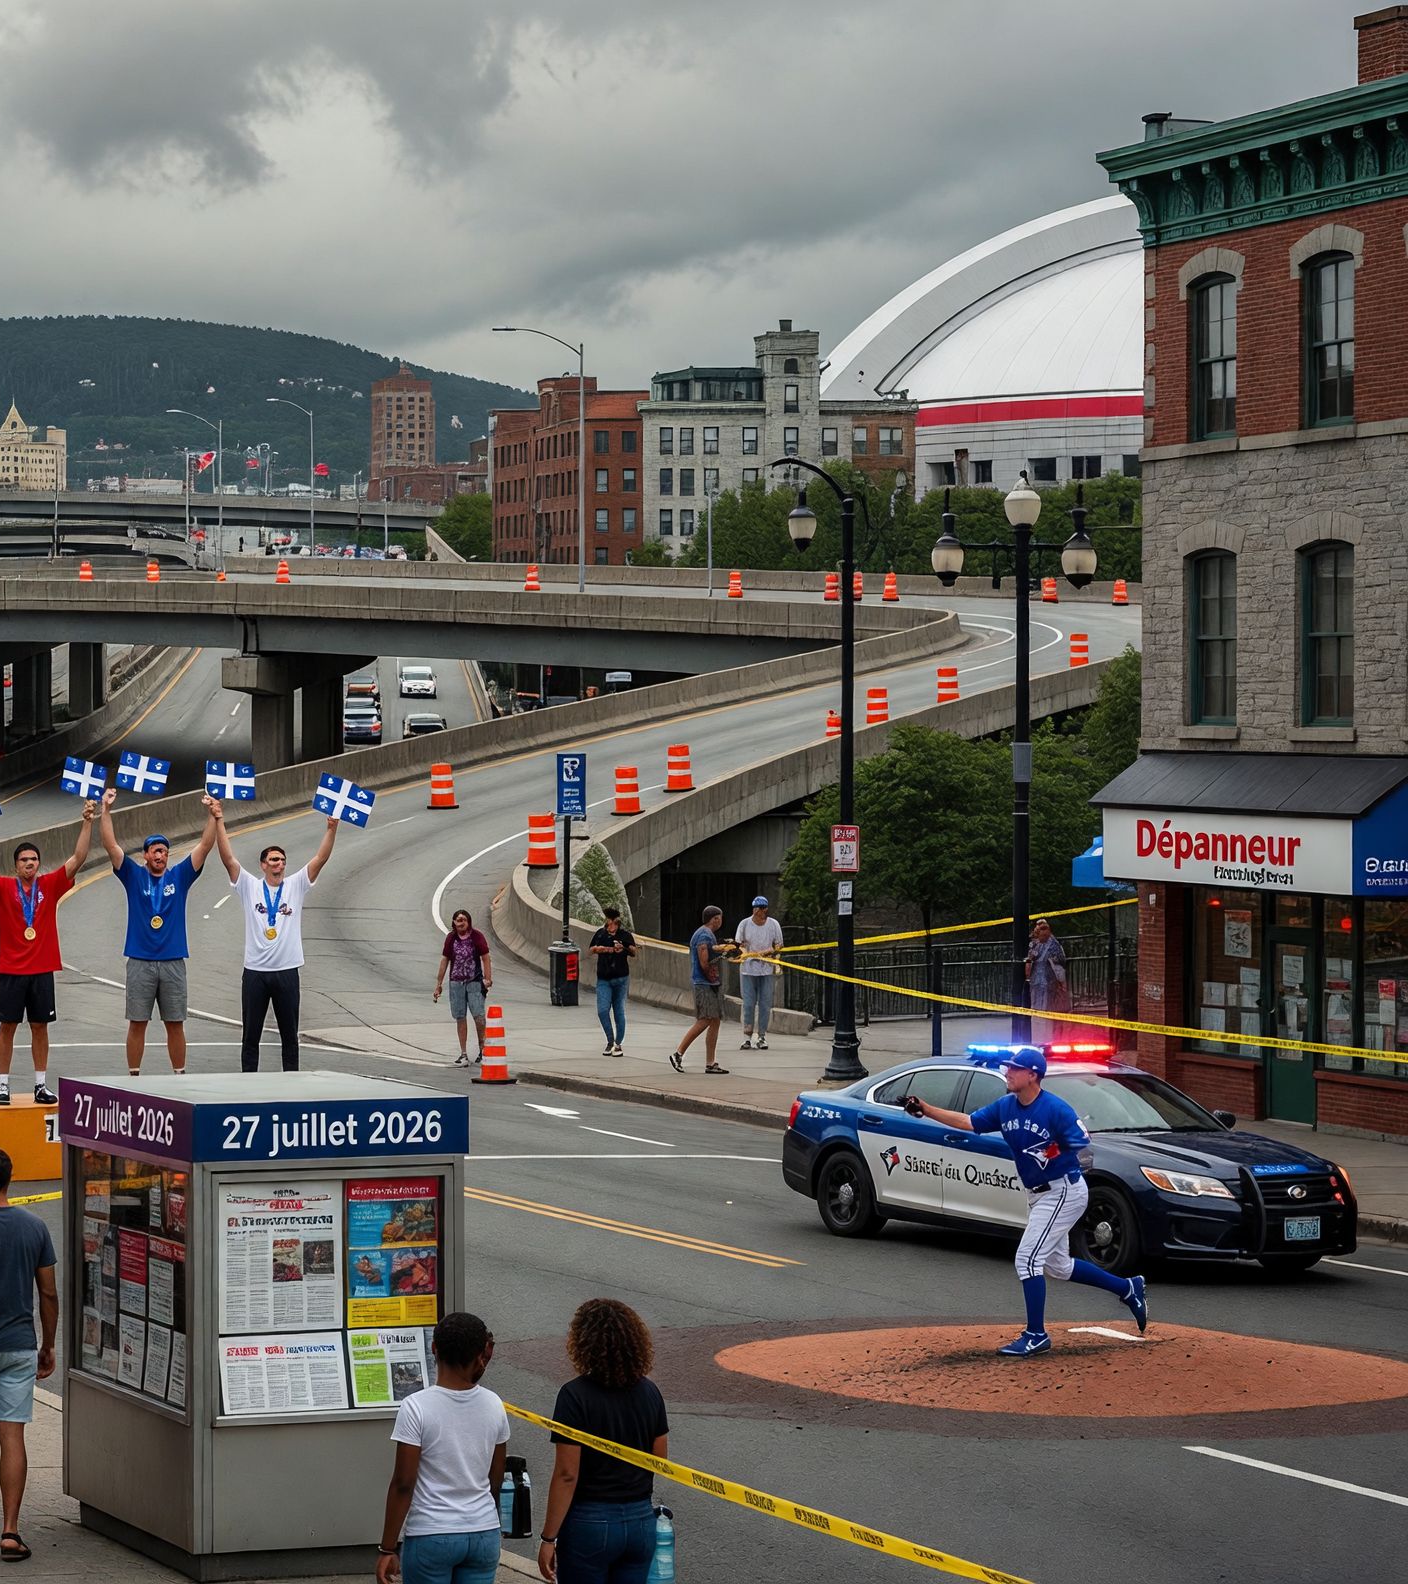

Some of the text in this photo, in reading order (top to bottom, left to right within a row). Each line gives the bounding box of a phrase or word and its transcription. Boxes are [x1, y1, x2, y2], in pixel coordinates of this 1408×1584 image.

[1136, 819, 1301, 869] Dépanneur
[74, 1093, 174, 1147] 27 juillet 2026
[222, 1110, 442, 1157] 27 juillet 2026
